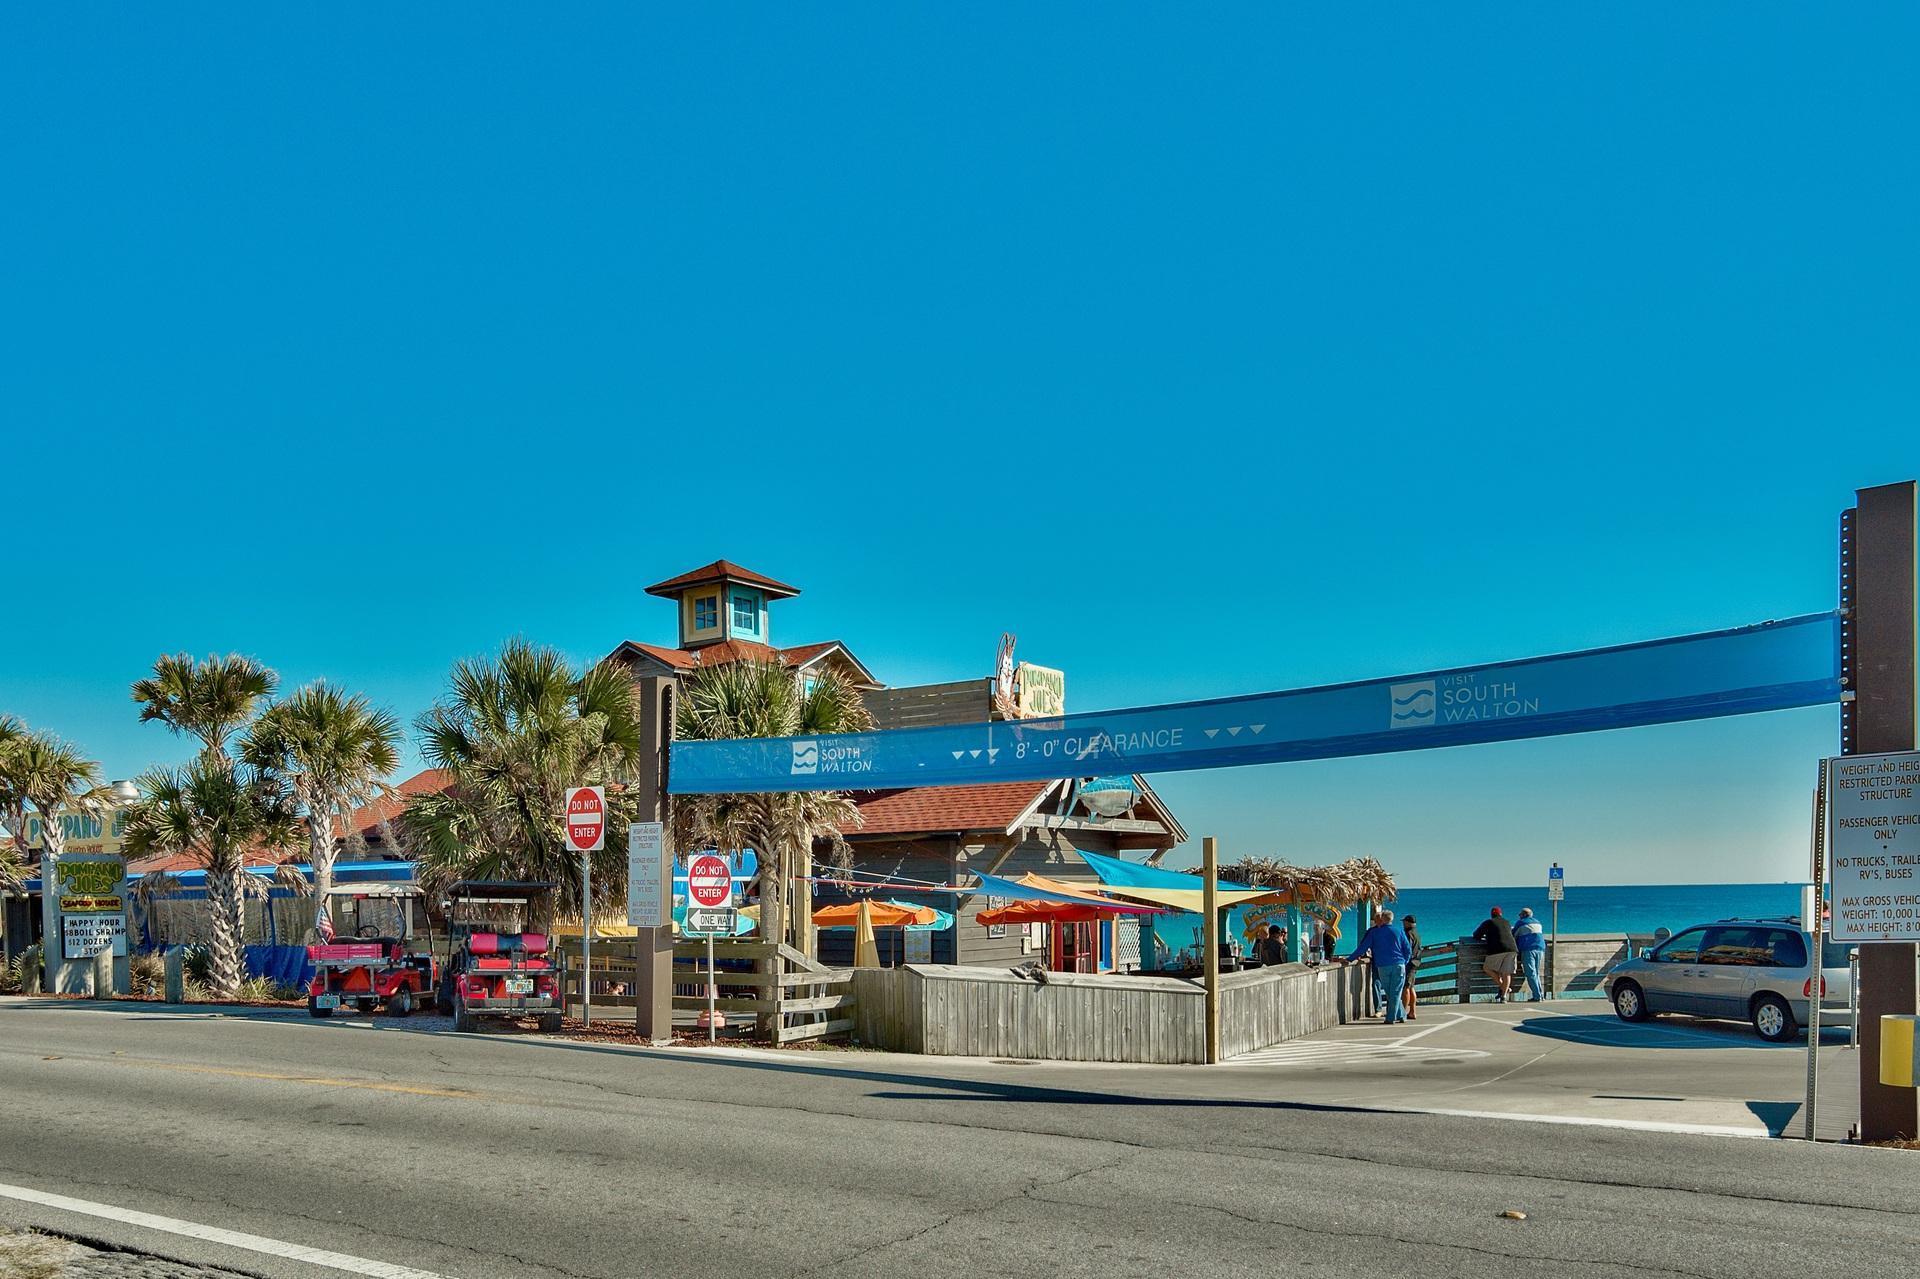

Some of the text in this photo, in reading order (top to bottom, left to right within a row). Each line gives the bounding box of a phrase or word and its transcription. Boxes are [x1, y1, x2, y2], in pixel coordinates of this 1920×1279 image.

[1442, 674, 1476, 687] VISIT
[1443, 682, 1516, 705] SOUTH
[1444, 698, 1539, 722] WALTON
[820, 739, 838, 747] VISIT
[1064, 727, 1184, 756] CLEARANCE
[821, 748, 860, 761] SOUTH
[821, 760, 872, 773] WALTON
[1840, 764, 1876, 775] WEIGHT
[1878, 762, 1896, 773] AND
[1839, 776, 1892, 789] RESTRICTED
[1860, 788, 1912, 800] STRUCTURE
[572, 799, 599, 811] DO NOT
[29, 813, 102, 842] PPANO
[1839, 816, 1889, 828] PASSENGER
[574, 827, 596, 838] ENTER
[1874, 829, 1897, 840] ONLY
[1836, 857, 1849, 868] NO
[1851, 855, 1889, 867] TRUCKS,
[57, 861, 123, 885] POMPANO
[695, 865, 723, 875] DO NOT
[1859, 868, 1913, 881] RV'S, BUSES
[698, 888, 722, 898] ENTER
[1842, 897, 1860, 907] MAX
[1862, 895, 1891, 906] GROSS
[700, 914, 732, 925] ONE WAY
[1842, 909, 1878, 920] WEIGHT:
[1882, 908, 1913, 920] 10,000
[69, 919, 94, 927] HAPPY
[1846, 923, 1865, 933] MAX
[1867, 921, 1903, 933] HEIGHT:
[96, 928, 126, 936] SHRIMP
[84, 937, 113, 945] DOZENS
